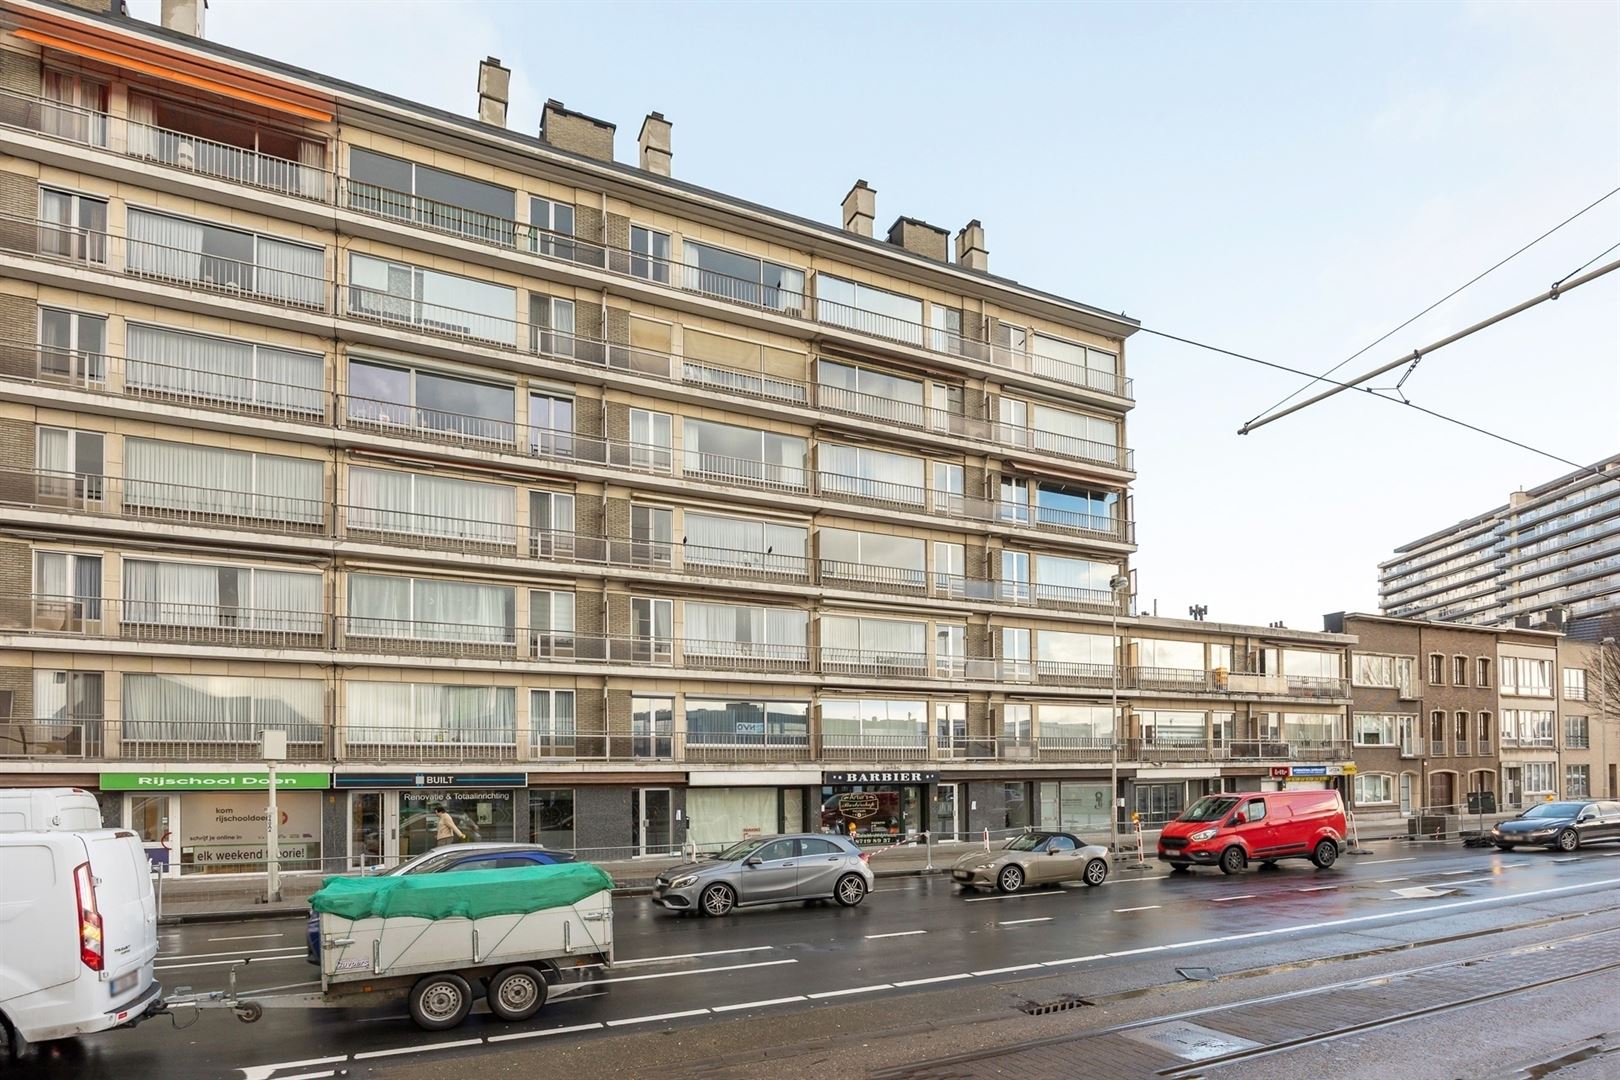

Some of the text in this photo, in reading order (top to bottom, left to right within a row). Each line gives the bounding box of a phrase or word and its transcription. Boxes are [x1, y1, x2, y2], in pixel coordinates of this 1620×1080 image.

[138, 777, 235, 786] Rijschool
[426, 776, 454, 784] BUILT
[846, 772, 922, 782] BARBIER
[403, 793, 444, 801] Renovatie
[453, 792, 510, 800] Totaalinrichting
[197, 850, 212, 861] elk
[215, 849, 263, 860] weekend
